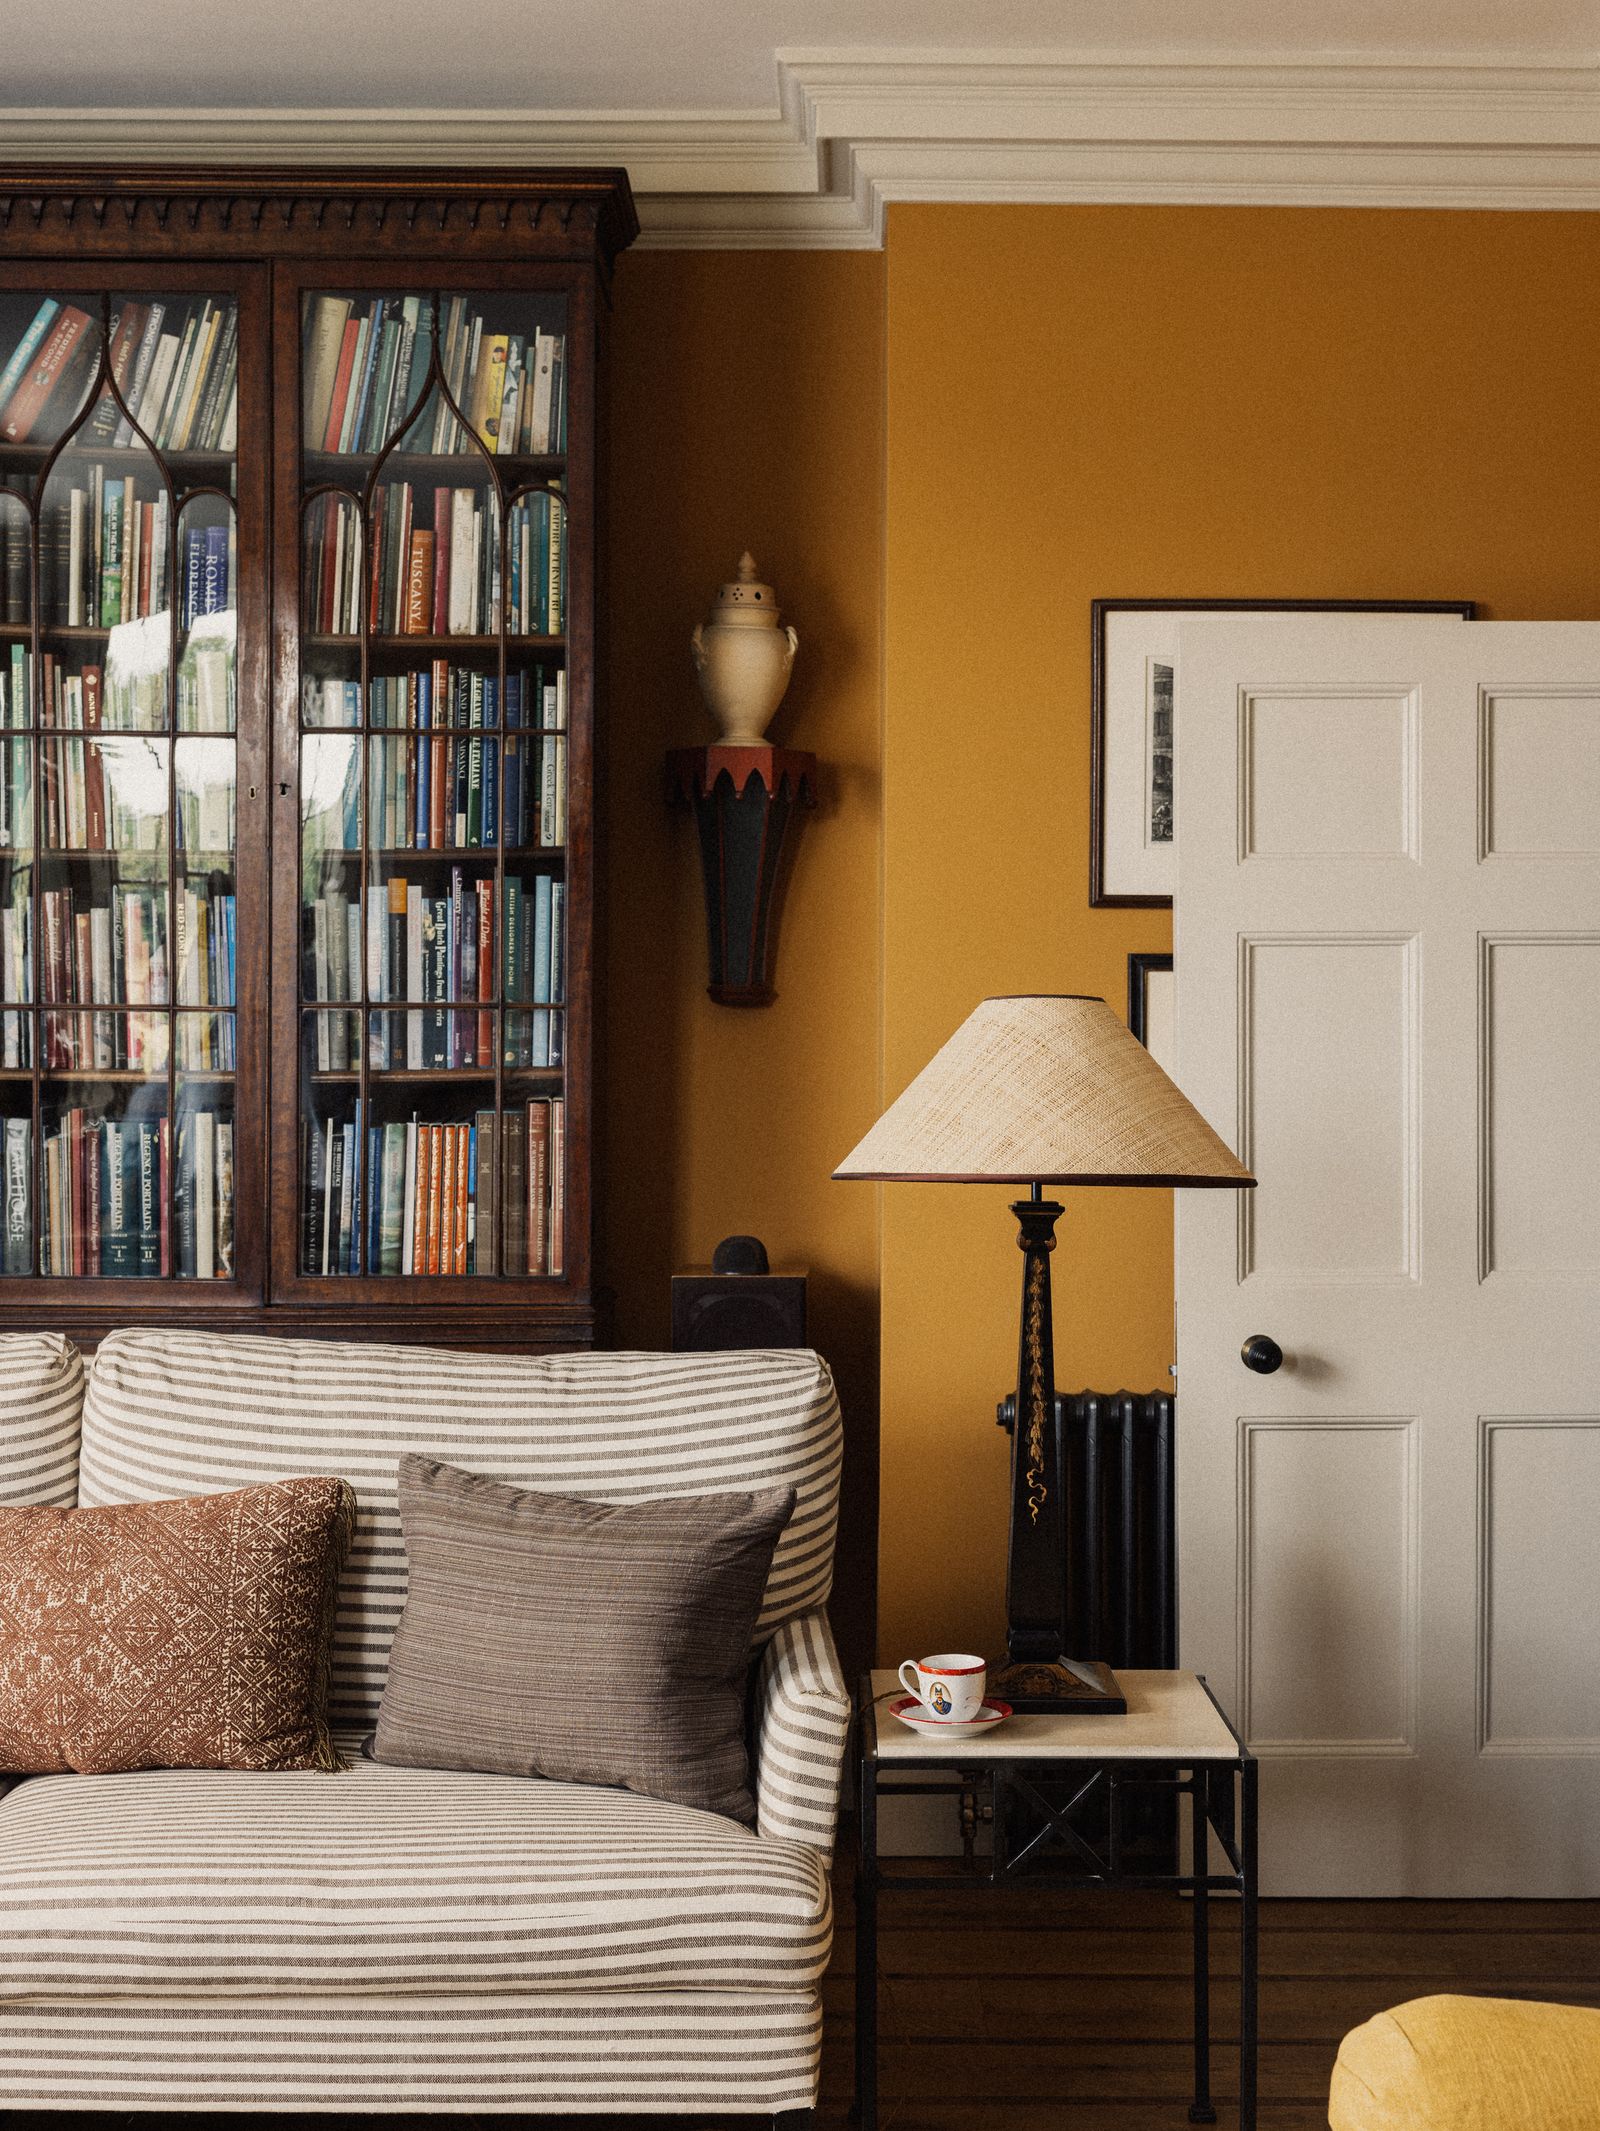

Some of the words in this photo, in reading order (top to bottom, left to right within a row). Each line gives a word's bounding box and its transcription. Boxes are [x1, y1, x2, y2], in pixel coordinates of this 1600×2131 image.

[60, 318, 71, 332] the
[145, 307, 162, 344] STRONG
[40, 332, 65, 368] SECOND
[48, 322, 79, 373] FREDERICK
[134, 346, 152, 383] WOMEN
[128, 384, 141, 403] FOR
[551, 505, 560, 547] EMPIRE
[205, 554, 218, 607] ROME
[411, 547, 424, 621] TUSCANY
[551, 552, 560, 613] FURNITURE
[472, 677, 482, 688] LE
[472, 689, 482, 721] GRANDI
[546, 702, 555, 719] The
[471, 749, 481, 789] ITALIANE
[546, 763, 555, 790] Greek
[177, 903, 185, 923] RED
[435, 901, 446, 921] Great
[453, 877, 462, 914] Chinnery
[479, 889, 490, 914] Wright
[435, 922, 447, 945] Dutch
[478, 925, 490, 947] Derby
[479, 915, 490, 925] of
[435, 945, 447, 978] Paintings
[437, 979, 446, 997] from
[11, 1138, 24, 1178] HAM
[114, 1133, 122, 1175] REGENCY
[143, 1133, 152, 1176] REGENCY
[310, 1131, 320, 1175] VISAGES
[90, 1167, 98, 1189] England
[310, 1180, 318, 1195] DU
[11, 1186, 25, 1242] HOUSE
[114, 1178, 123, 1231] PORTRAITS
[144, 1179, 152, 1231] PORTRAITS
[309, 1198, 317, 1233] GRAND
[90, 1229, 98, 1250] Hogarth
